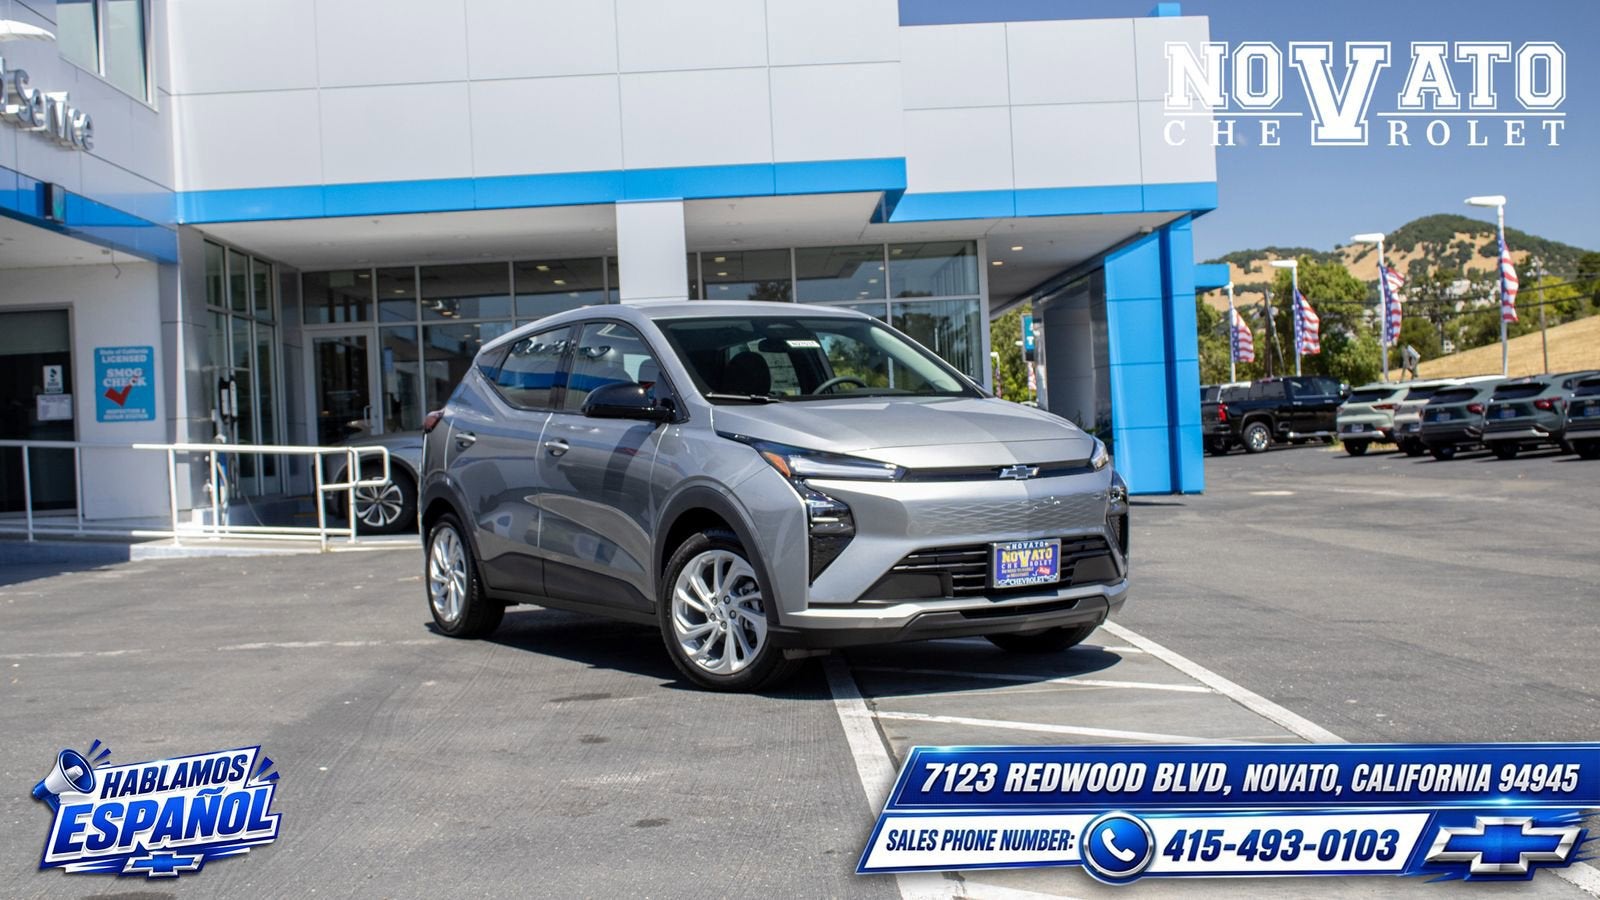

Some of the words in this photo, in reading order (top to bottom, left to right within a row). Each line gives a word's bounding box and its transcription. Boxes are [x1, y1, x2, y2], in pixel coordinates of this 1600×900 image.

[101, 355, 148, 363] LICENSED
[106, 368, 143, 378] SMOG
[103, 377, 147, 387] CHECK
[1011, 542, 1044, 550] NOVATO
[1002, 547, 1052, 567] NOVATO
